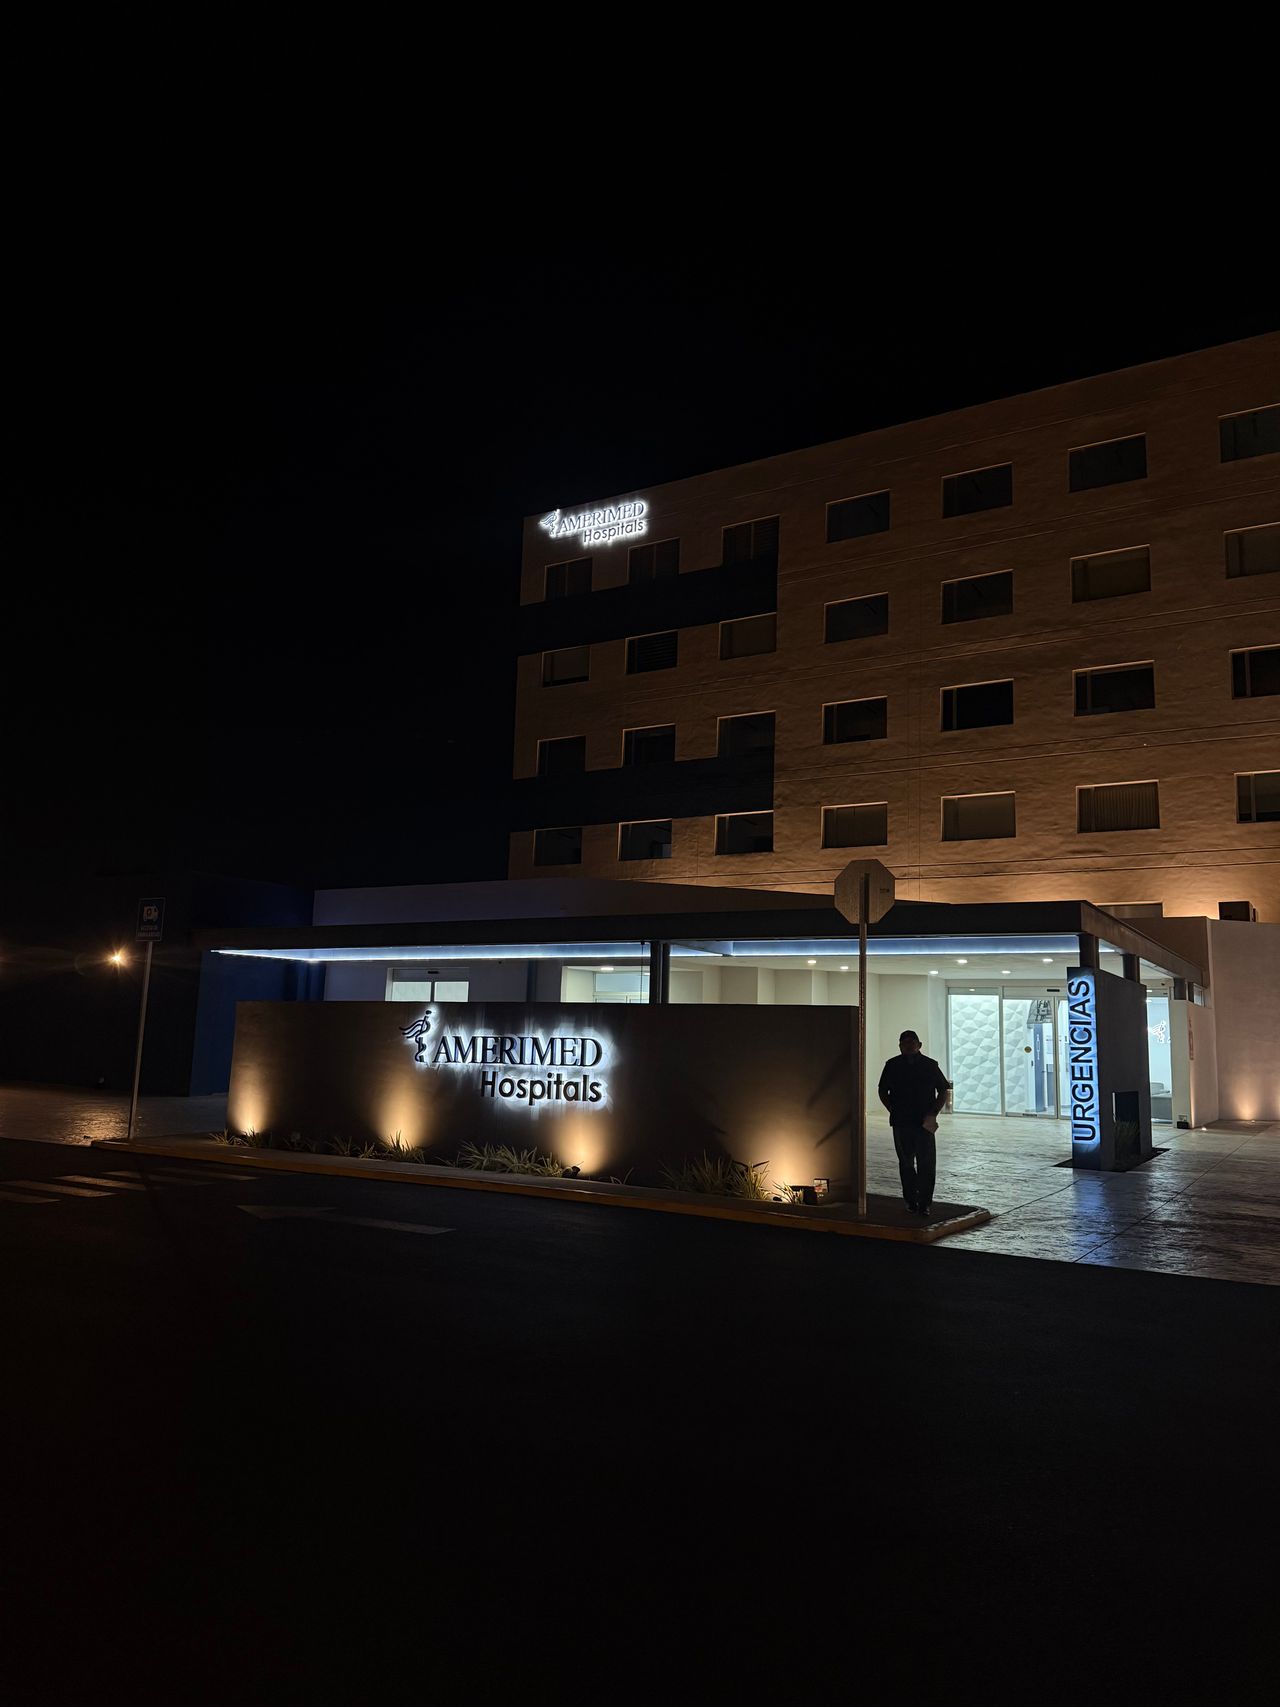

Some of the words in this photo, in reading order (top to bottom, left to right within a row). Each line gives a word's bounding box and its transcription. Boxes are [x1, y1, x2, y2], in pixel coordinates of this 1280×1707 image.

[557, 502, 645, 534] AMERIMED
[583, 519, 644, 542] Hospitals
[432, 1035, 603, 1067] AMERIMED
[1067, 980, 1096, 1142] URGENCIAS
[480, 1070, 602, 1106] Hospitals
